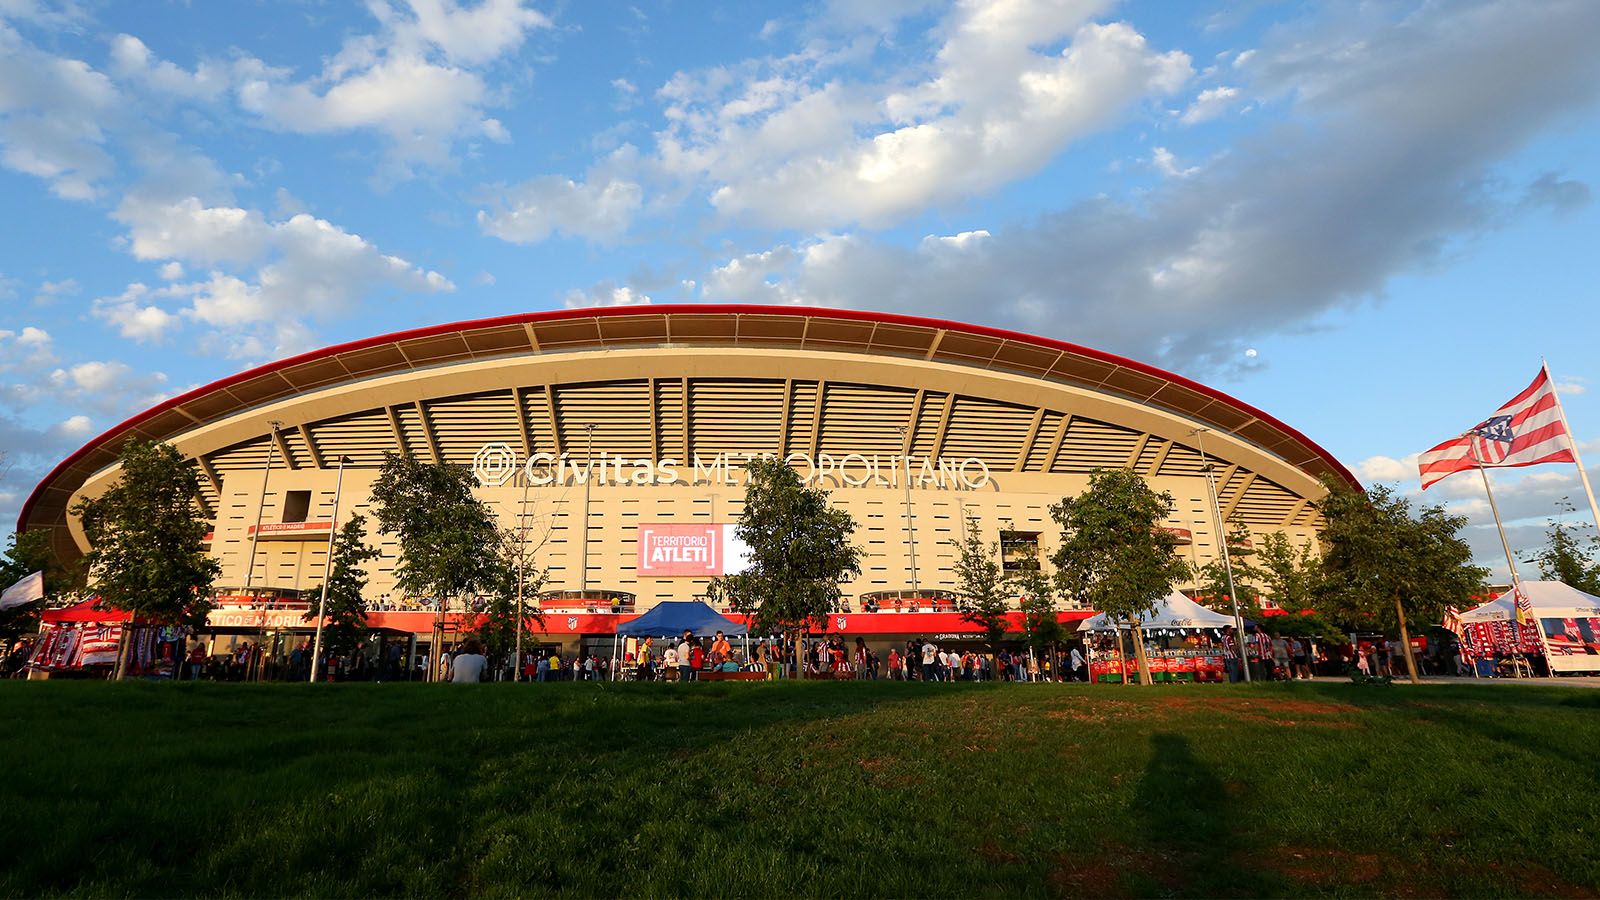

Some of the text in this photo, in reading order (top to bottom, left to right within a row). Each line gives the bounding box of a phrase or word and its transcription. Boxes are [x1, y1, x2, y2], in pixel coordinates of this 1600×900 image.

[525, 452, 679, 485] Cívitas
[652, 535, 708, 546] TERRITORIO
[651, 547, 708, 562] ATLETI
